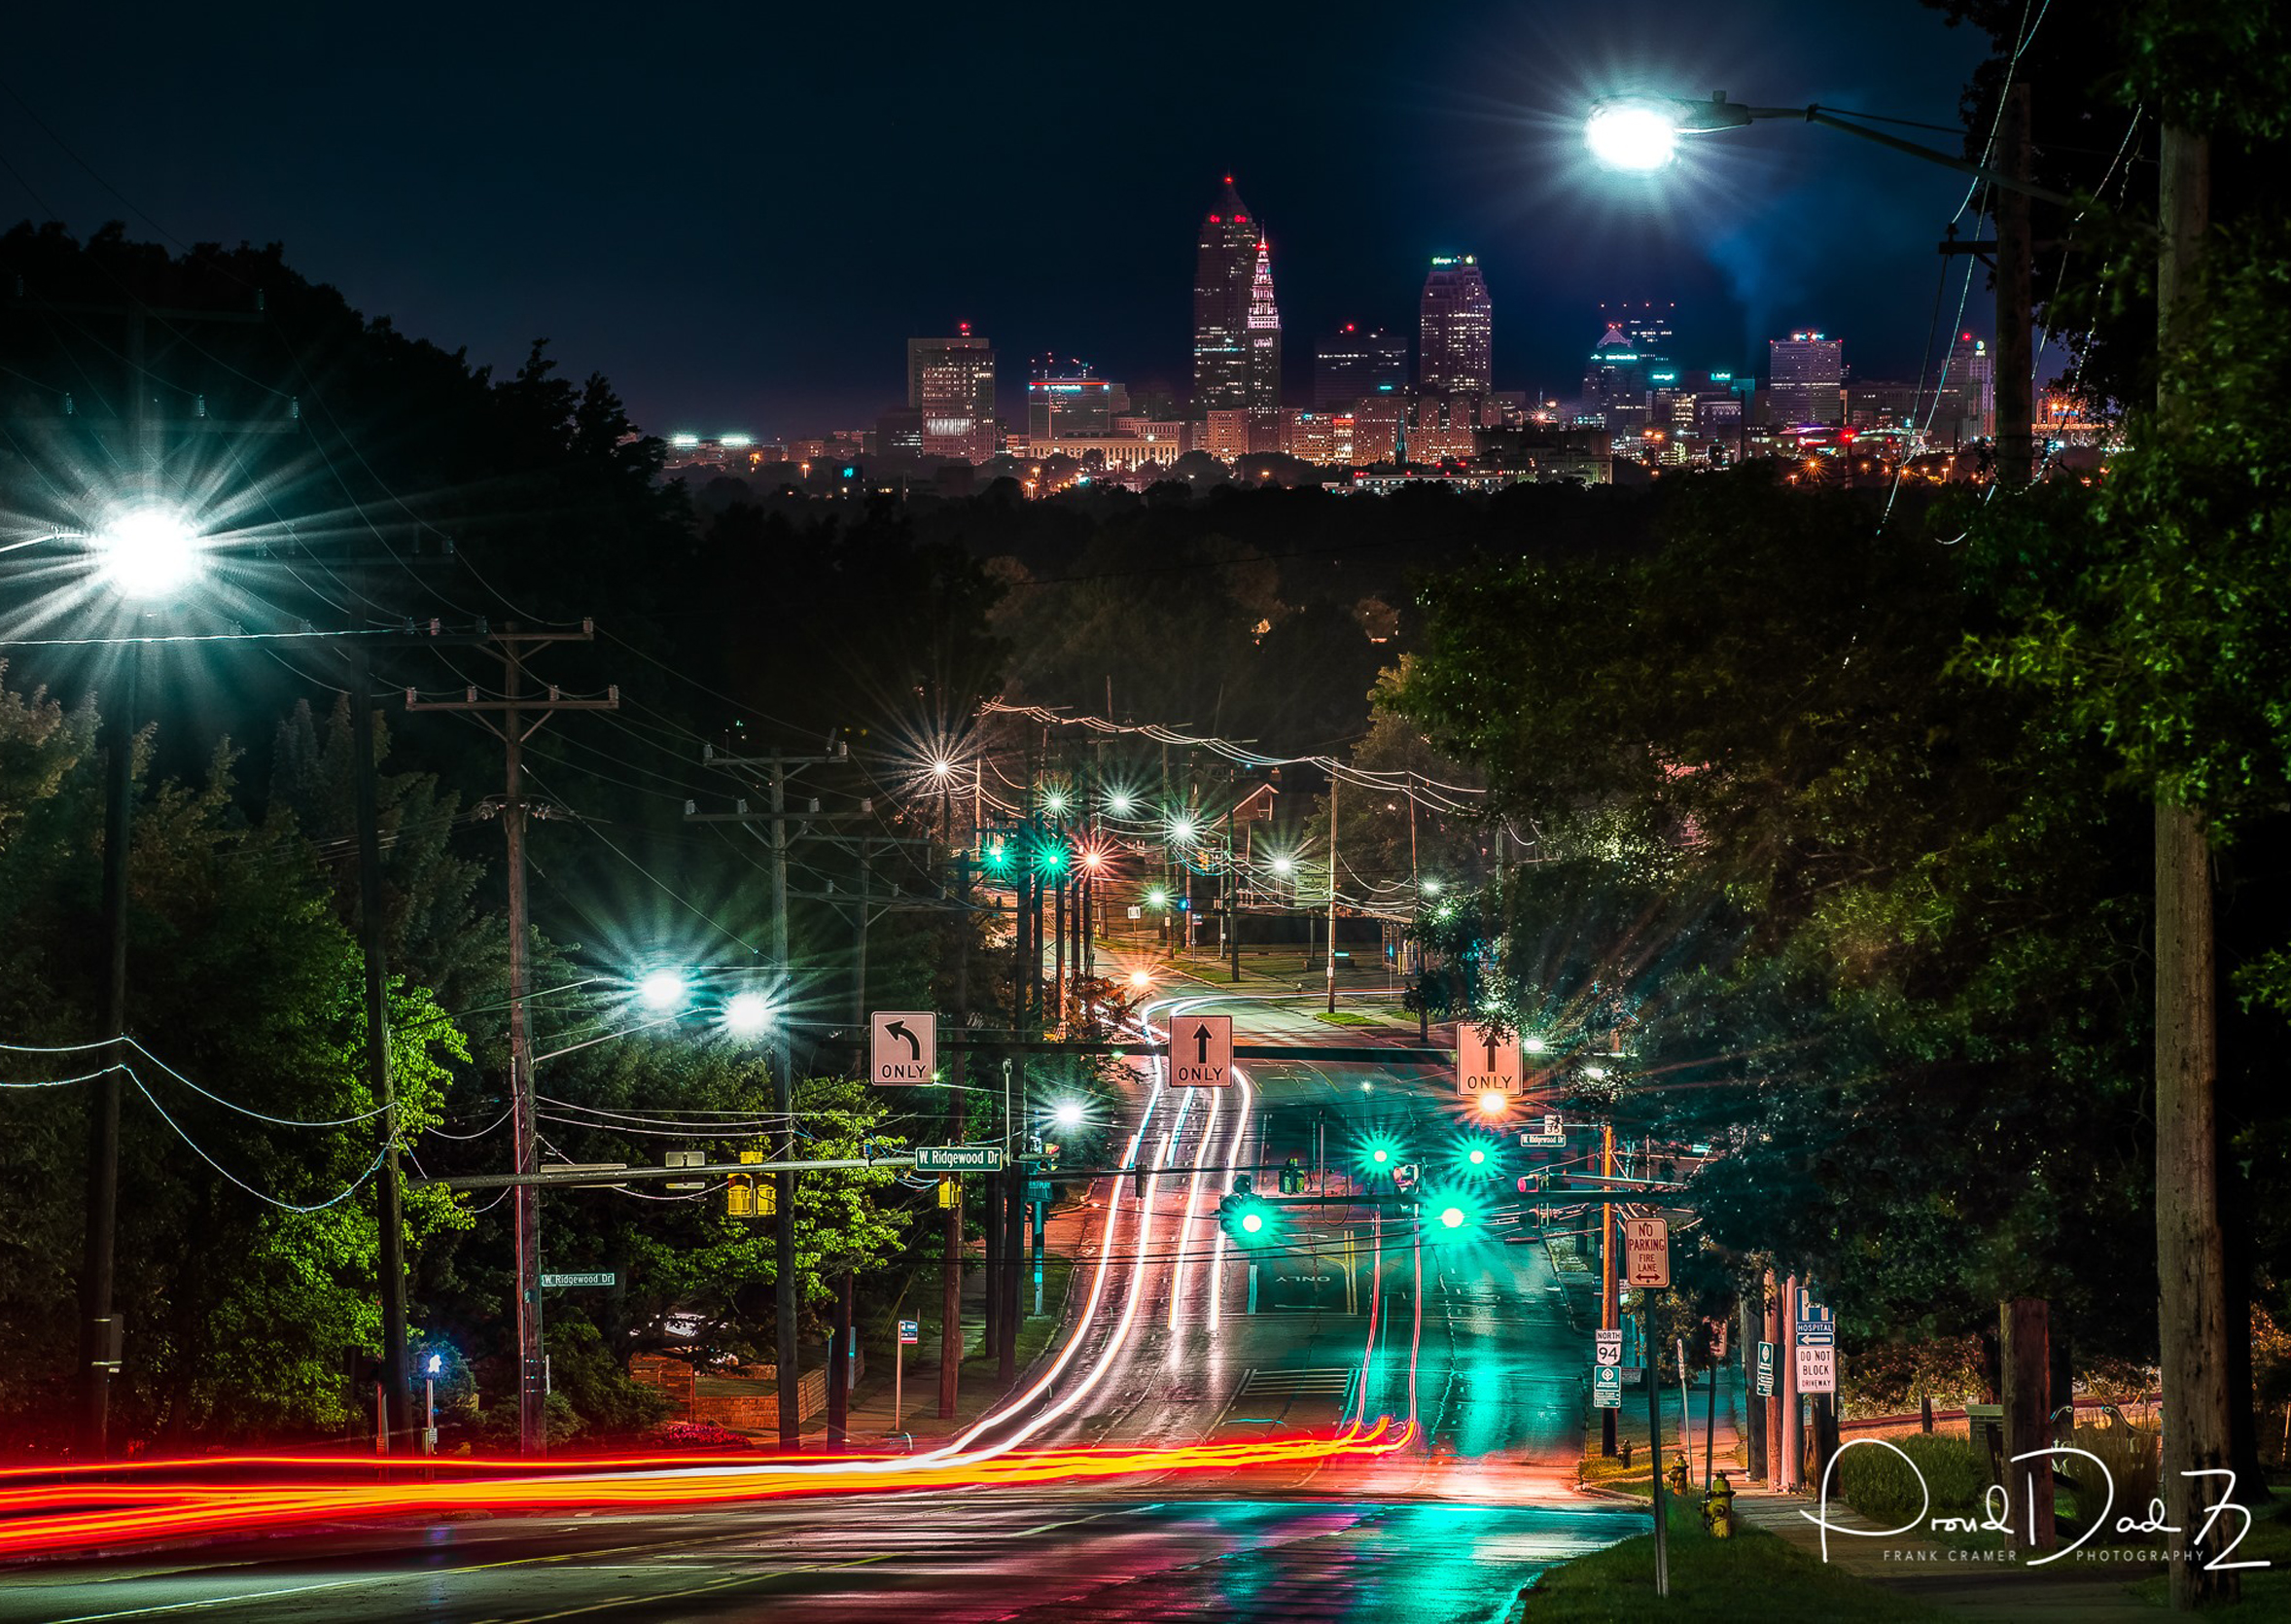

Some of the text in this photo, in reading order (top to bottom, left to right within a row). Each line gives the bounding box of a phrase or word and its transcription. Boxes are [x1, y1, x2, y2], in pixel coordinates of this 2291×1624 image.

[881, 1064, 927, 1078] ONLY
[1178, 1067, 1223, 1081] ONLY
[1466, 1076, 1512, 1089] ONLY
[932, 1149, 984, 1168] Ridgewood
[987, 1149, 999, 1164] Dr
[1639, 1224, 1653, 1237] NO
[1629, 1238, 1665, 1252] PARKING
[1639, 1253, 1655, 1263] FIRE
[1638, 1263, 1657, 1272] LANE
[555, 1274, 598, 1286] Ridgewood
[601, 1274, 612, 1283] Dr
[1798, 1324, 1833, 1332] HOSPITAL
[1597, 1331, 1621, 1340] NORTH
[1598, 1346, 1618, 1360] 94
[1800, 1350, 1831, 1361] DO NOT
[1802, 1364, 1829, 1376] BLOCK
[1801, 1379, 1831, 1388] DRIVEWAY
